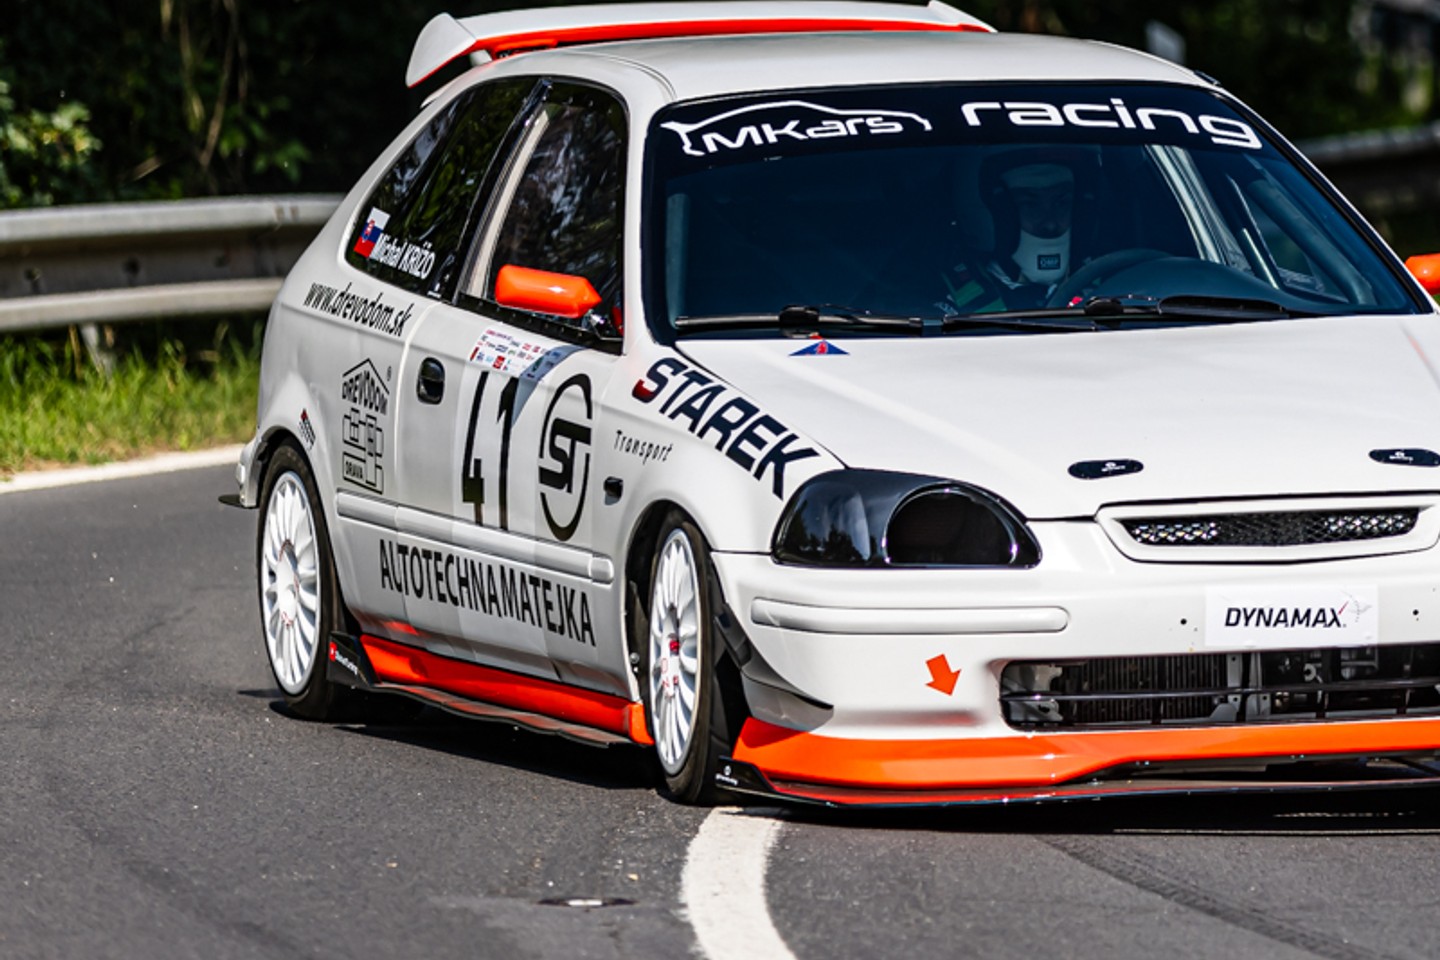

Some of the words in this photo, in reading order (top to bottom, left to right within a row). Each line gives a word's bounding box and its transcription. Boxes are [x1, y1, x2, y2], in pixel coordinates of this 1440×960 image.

[701, 117, 904, 153] MKars
[961, 97, 1264, 150] racing
[303, 281, 415, 337] www.drevodom.sk
[461, 371, 519, 531] 41
[614, 429, 675, 466] Transport
[631, 357, 820, 501] STAREK
[1224, 602, 1348, 629] DYNAMAX
